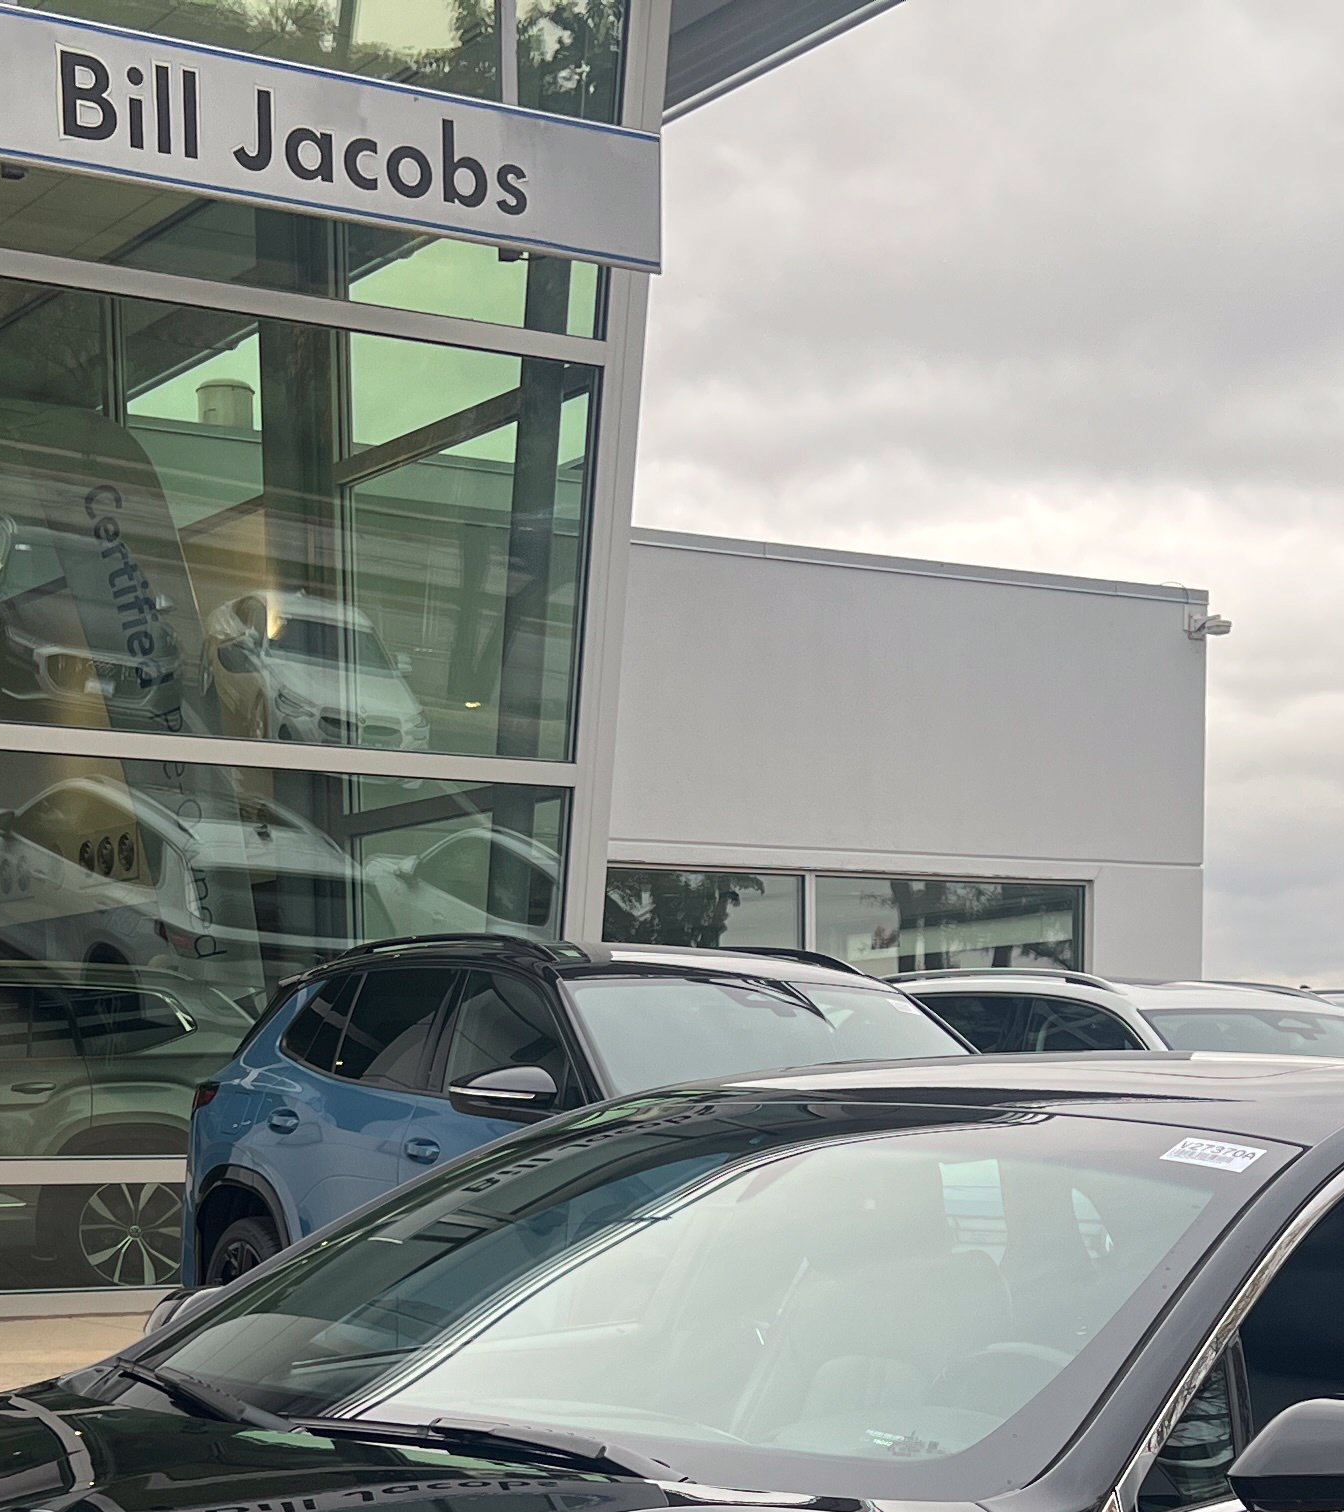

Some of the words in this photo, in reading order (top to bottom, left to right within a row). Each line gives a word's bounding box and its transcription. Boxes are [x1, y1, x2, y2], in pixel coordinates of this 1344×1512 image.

[59, 50, 199, 160] Bill
[233, 88, 529, 217] Jacobs
[84, 484, 175, 690] Certified
